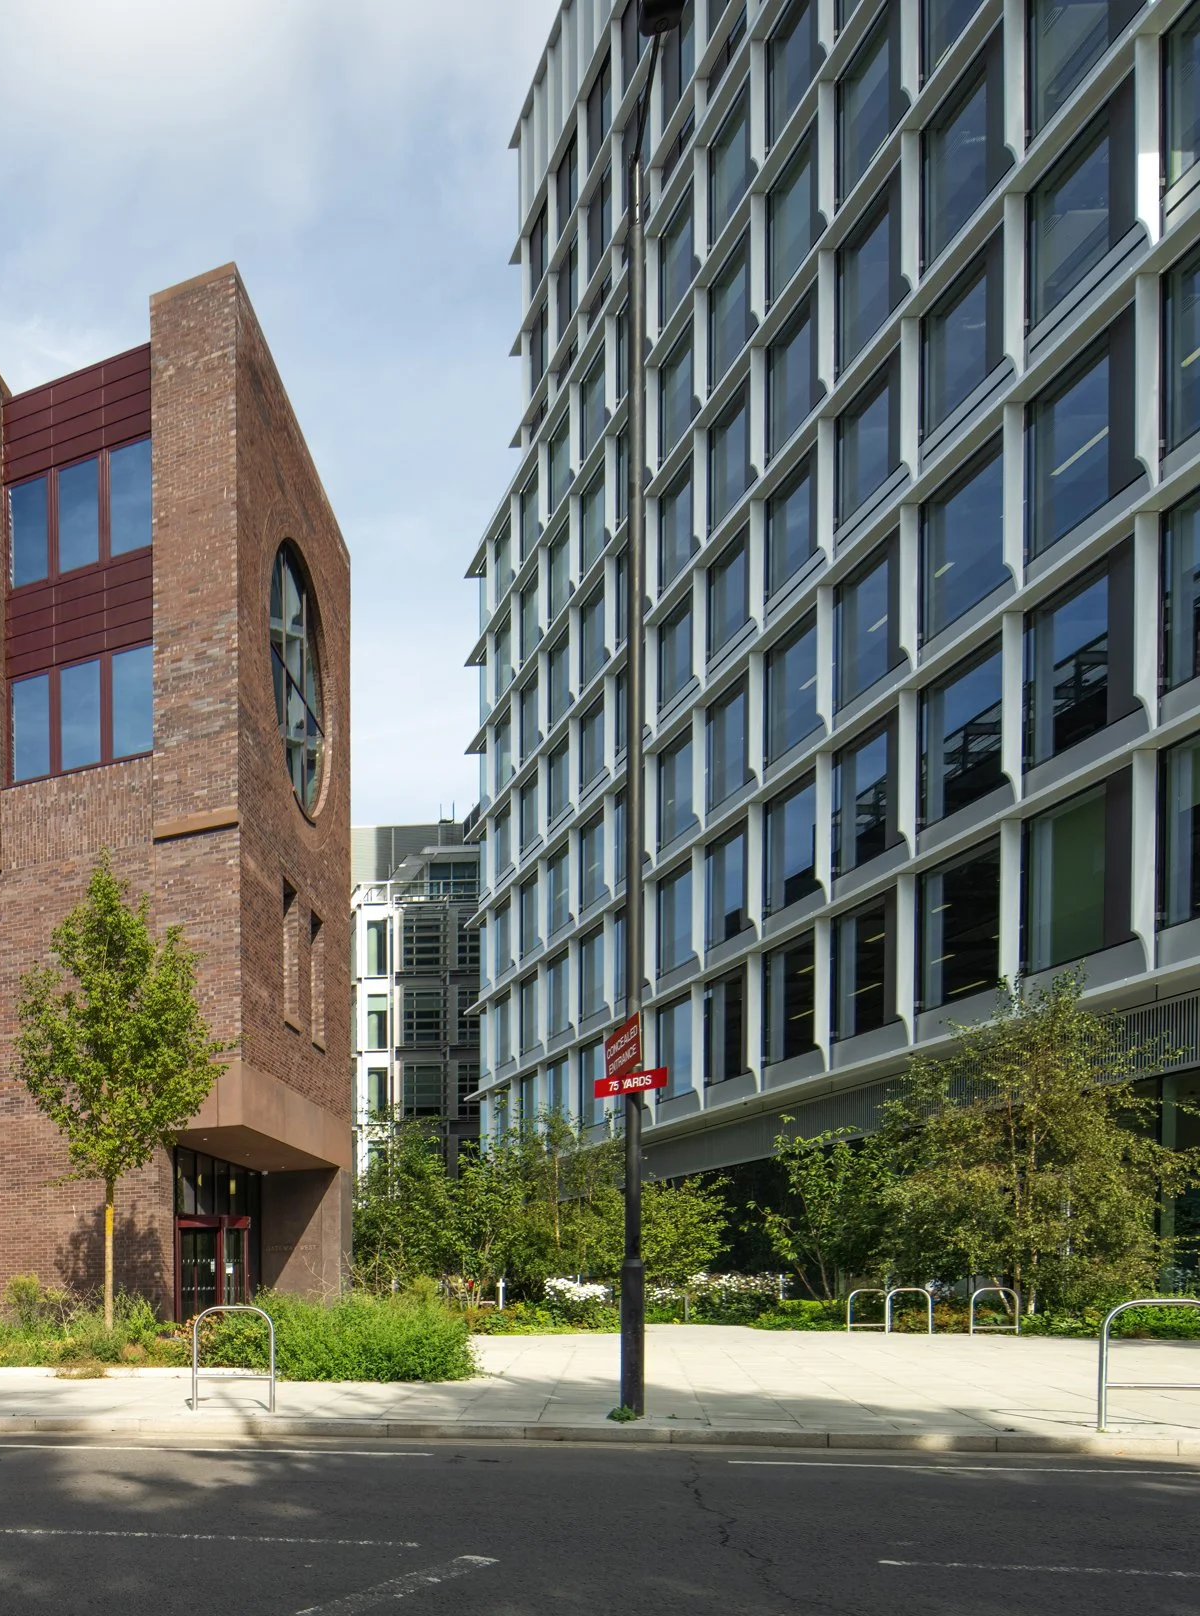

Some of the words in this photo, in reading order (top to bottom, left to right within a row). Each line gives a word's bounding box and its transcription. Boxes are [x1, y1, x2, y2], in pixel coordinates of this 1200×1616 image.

[607, 1025, 638, 1059] CONCEALED
[608, 1043, 637, 1075] ENTRANCE
[608, 1081, 619, 1092] 75
[622, 1075, 652, 1089] YARDS
